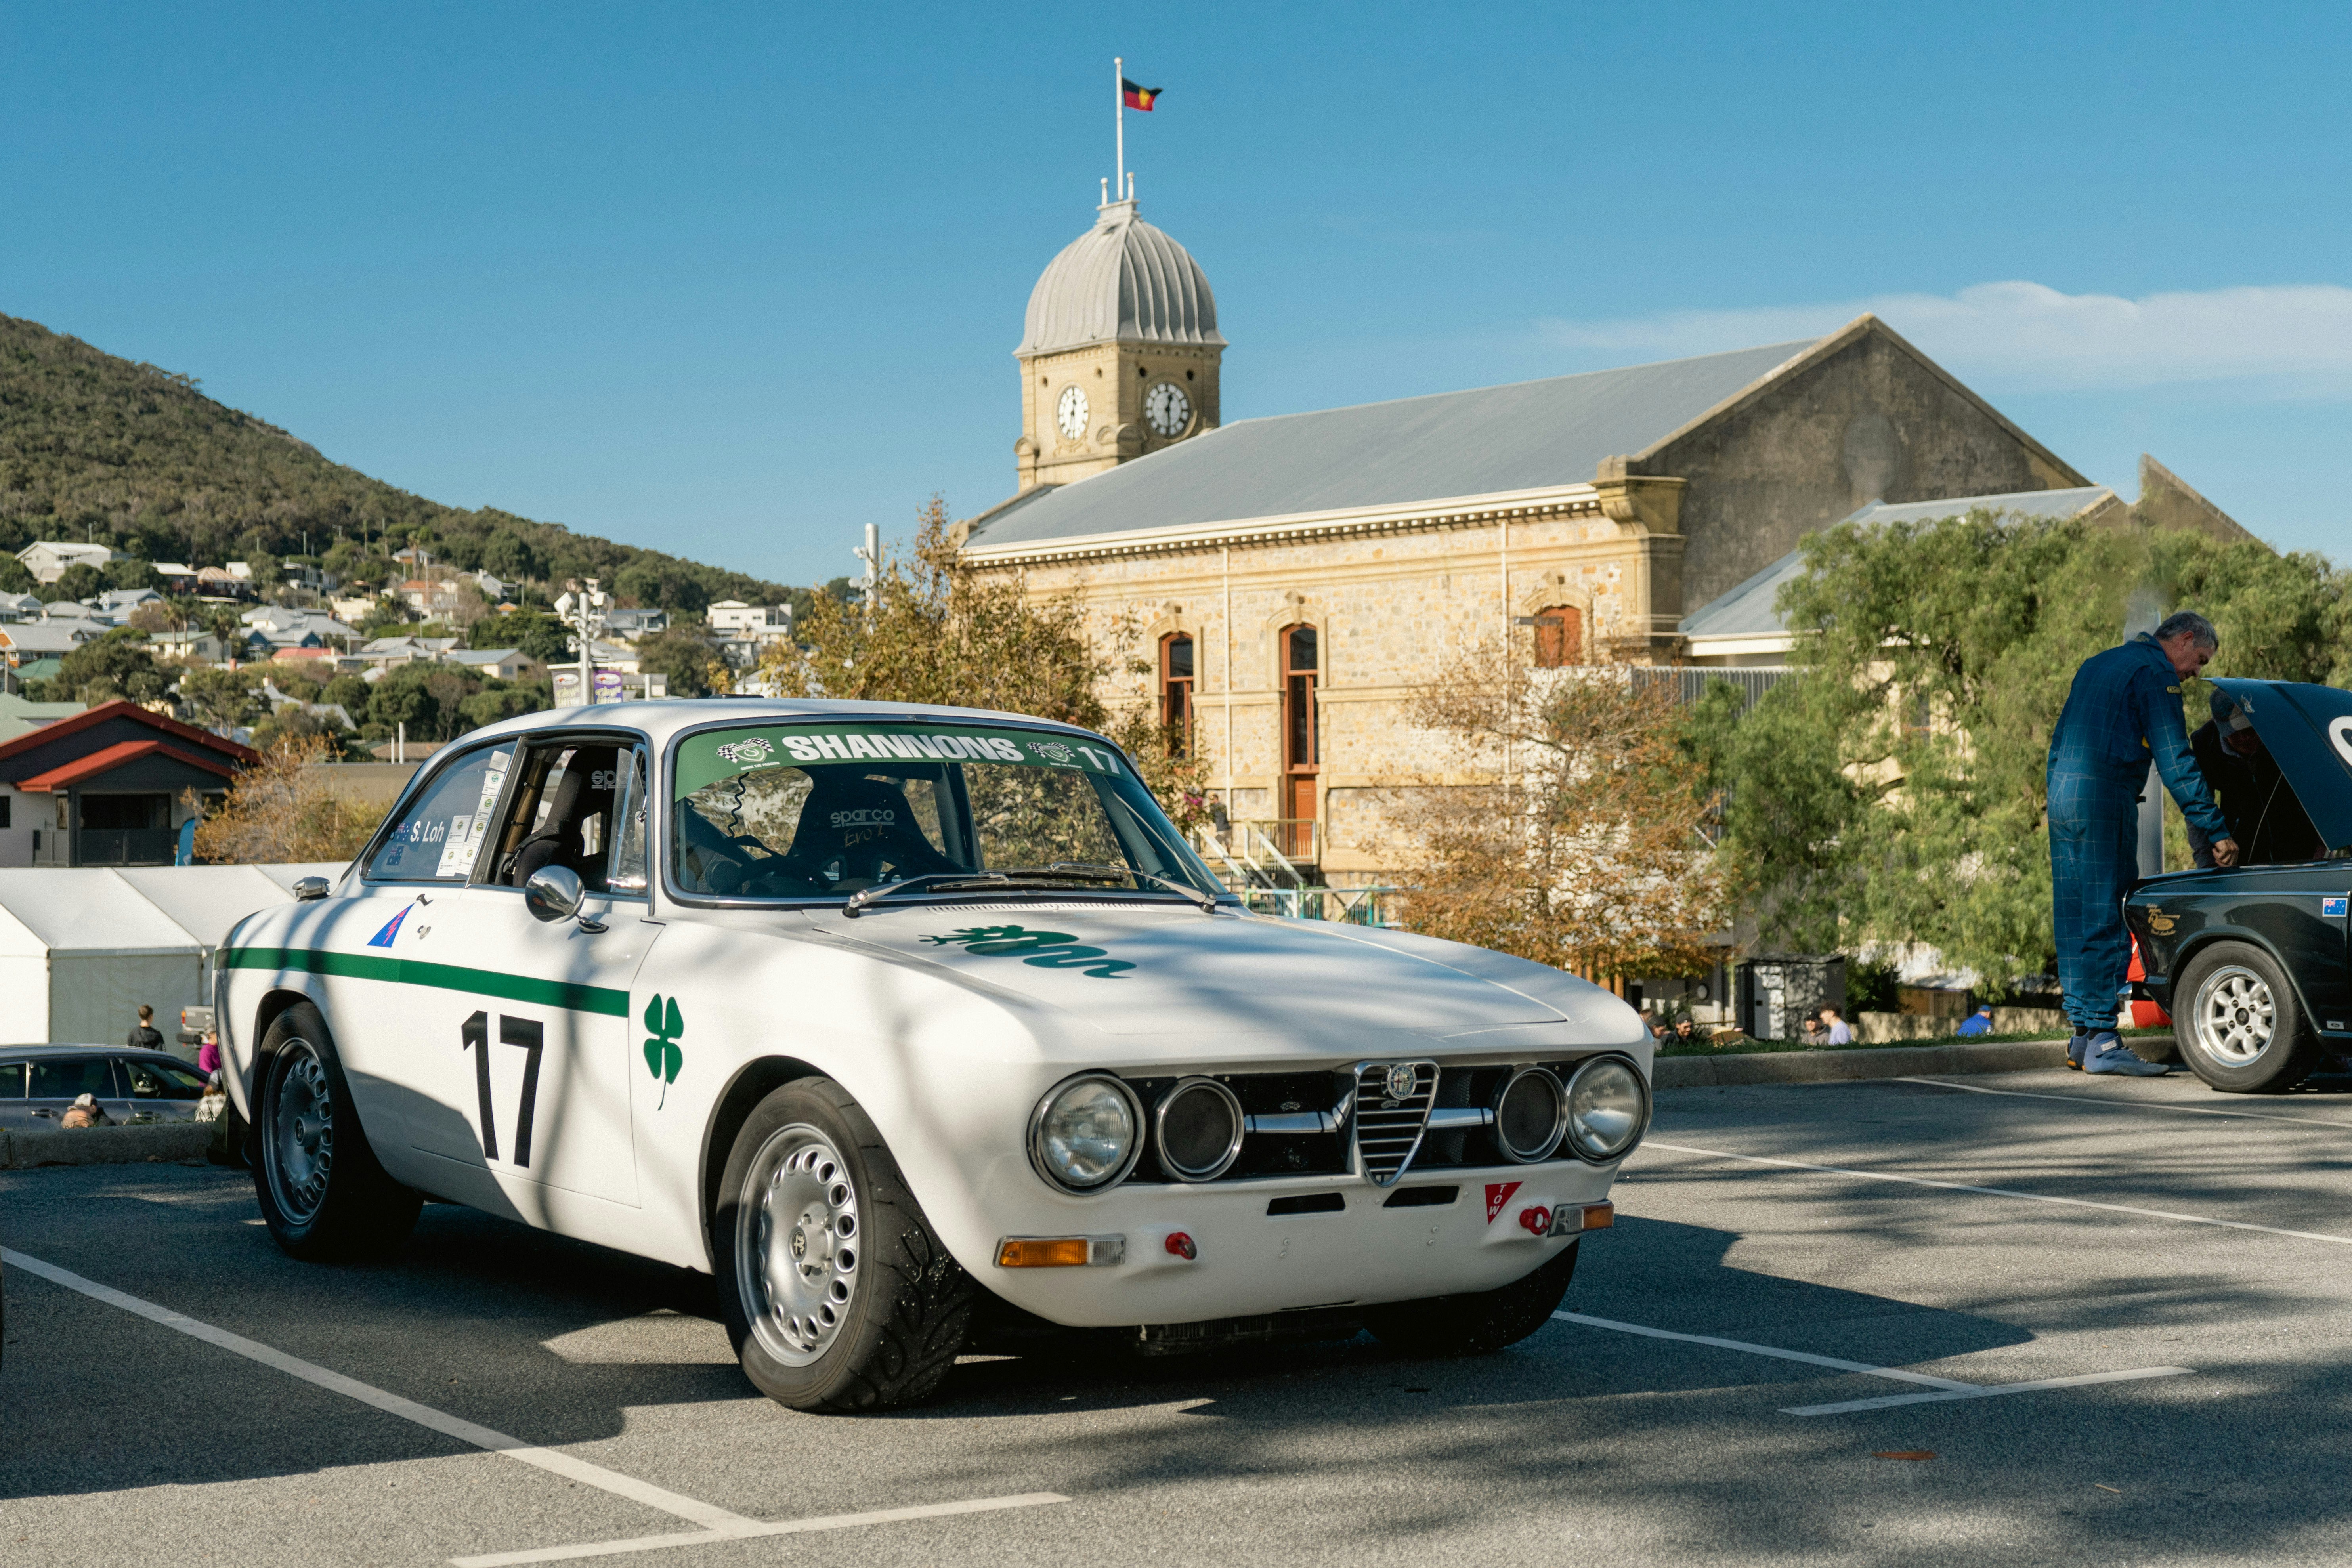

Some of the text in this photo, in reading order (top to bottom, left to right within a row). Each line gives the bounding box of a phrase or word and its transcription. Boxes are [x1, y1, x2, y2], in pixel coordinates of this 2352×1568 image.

[782, 735, 1024, 761] SHANNONS
[1077, 746, 1120, 774] 17
[410, 821, 444, 842] S. Loh
[830, 809, 894, 827] sparco
[461, 1010, 543, 1168] 17
[1489, 1184, 1507, 1215] TOW
